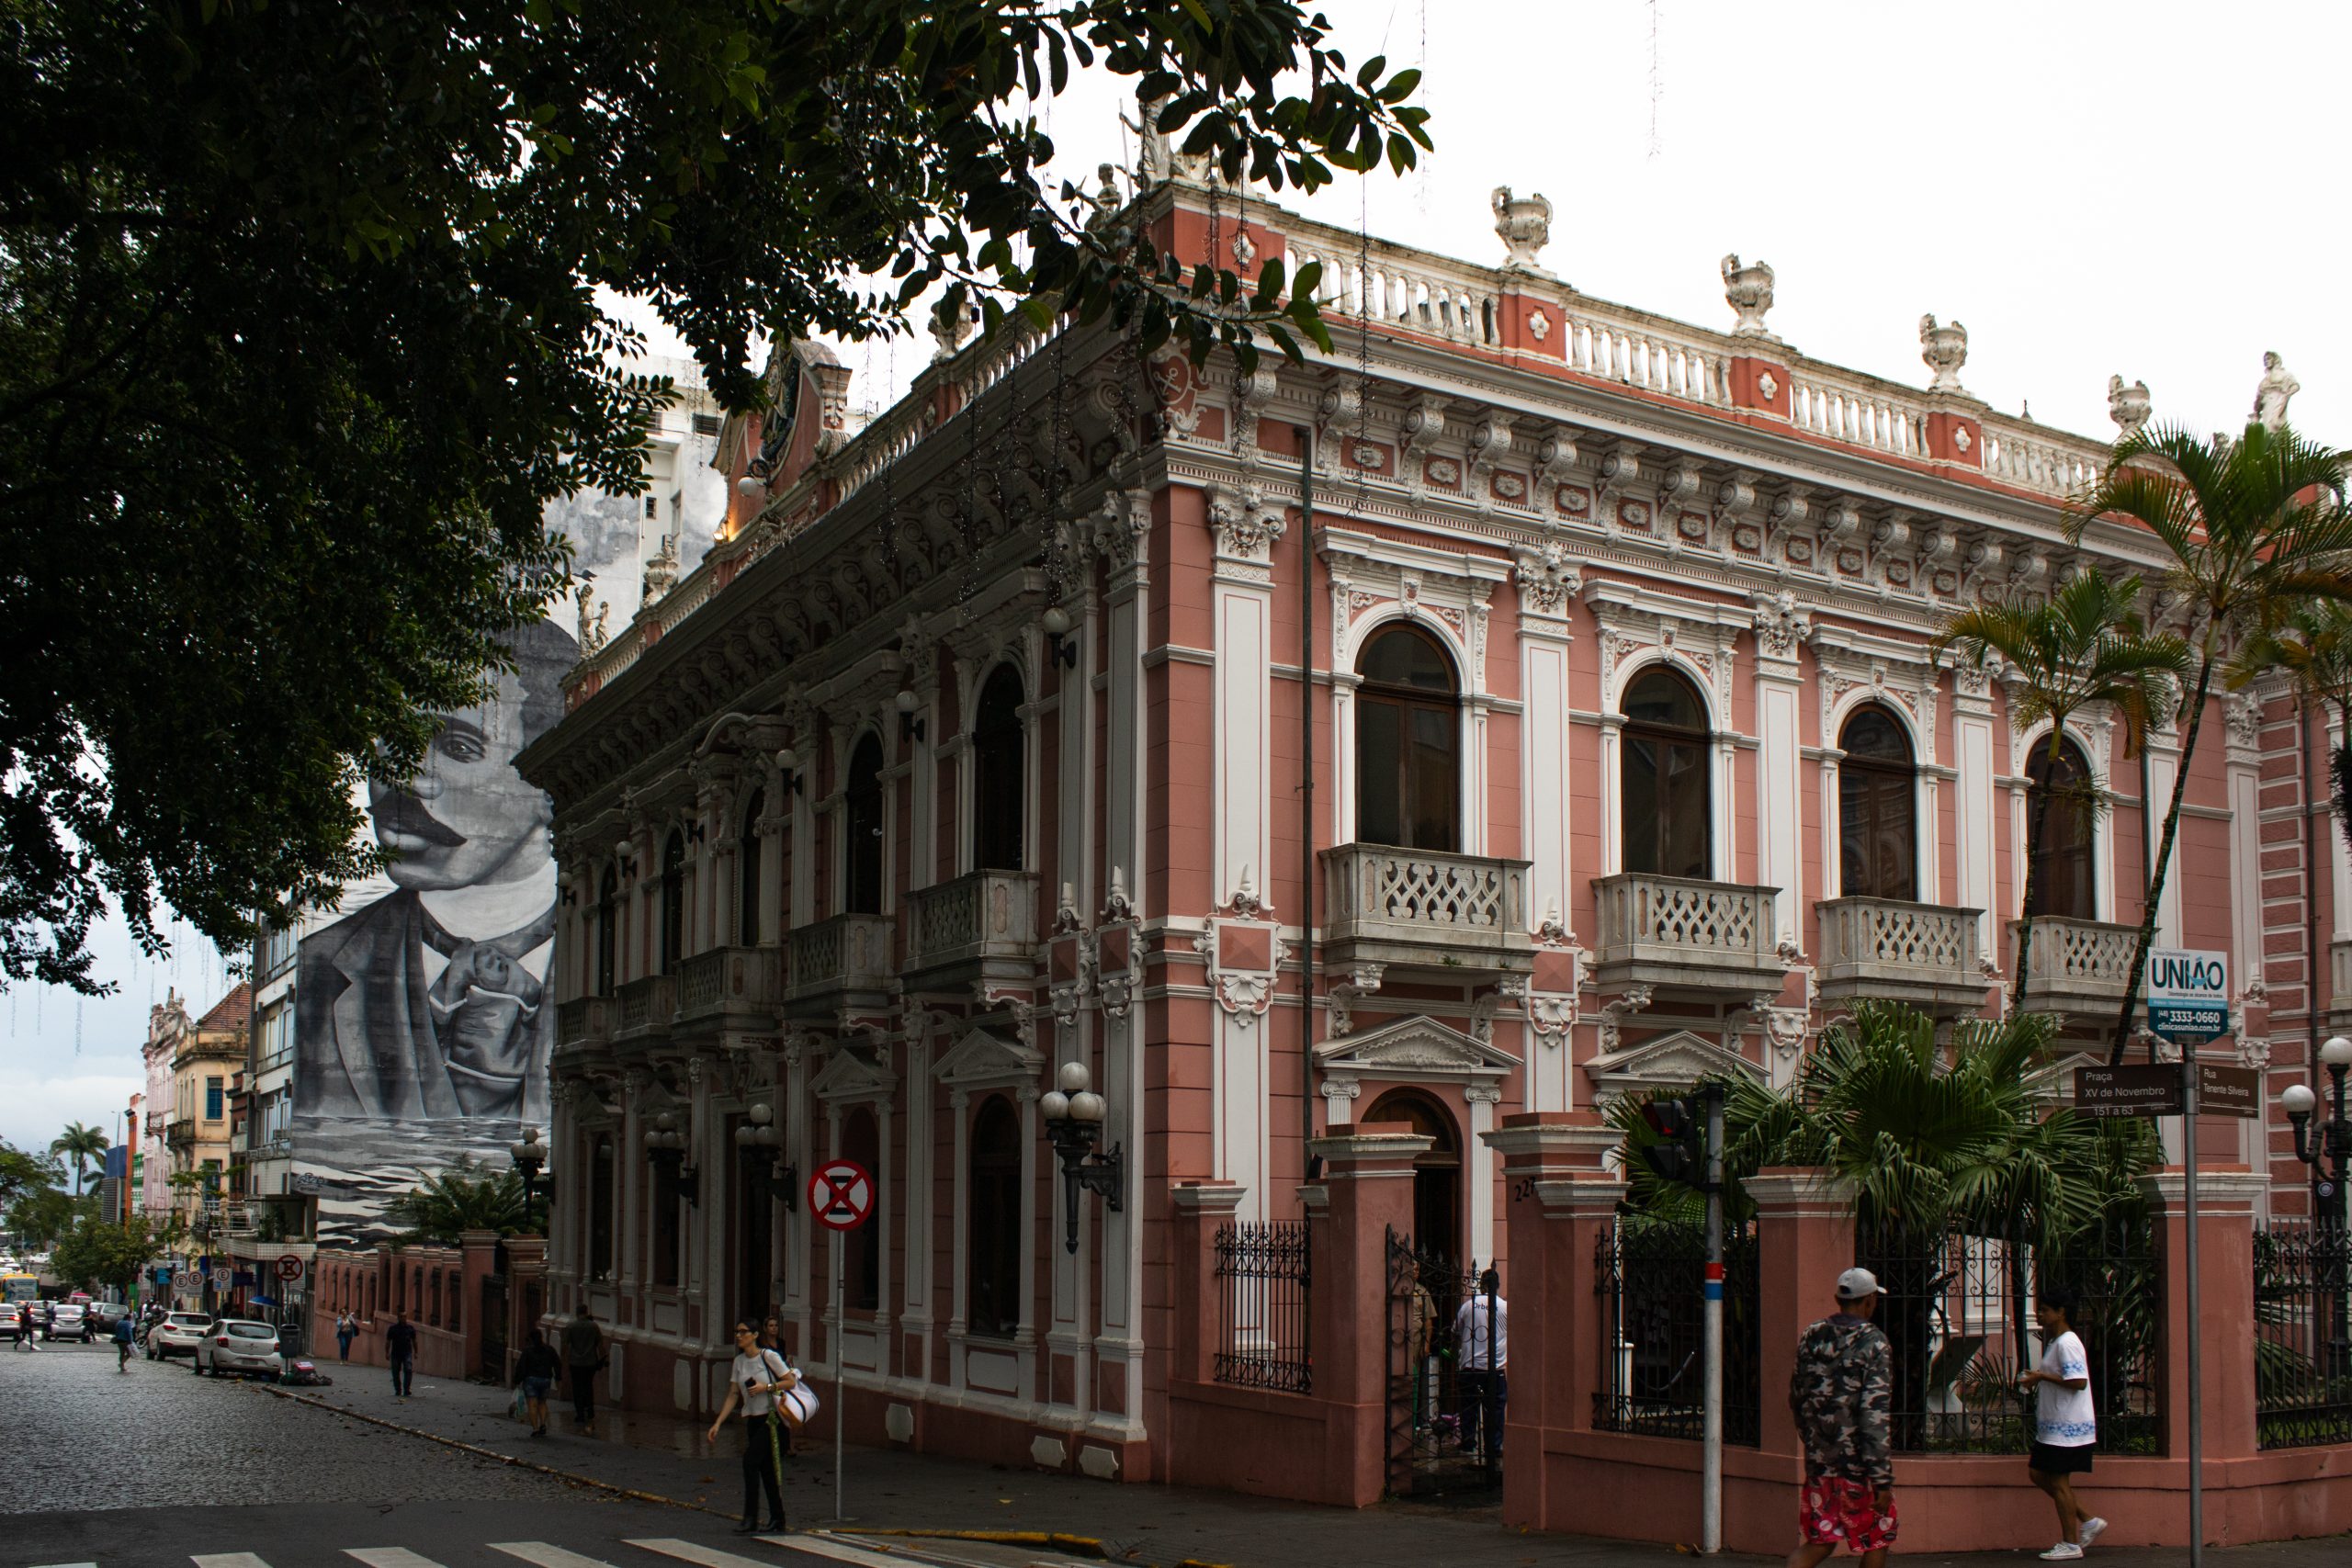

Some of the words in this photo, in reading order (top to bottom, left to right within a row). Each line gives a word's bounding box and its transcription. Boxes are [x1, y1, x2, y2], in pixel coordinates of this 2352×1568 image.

[2152, 956, 2223, 990] UNIÃO
[2169, 1010, 2221, 1023] 3333-0660
[2086, 1072, 2112, 1083] Praça
[2204, 1068, 2217, 1078] Rua
[2085, 1088, 2098, 1098] XV
[2100, 1088, 2113, 1098] de
[2115, 1087, 2165, 1097] Novembro
[2203, 1082, 2227, 1095] Tenente
[2227, 1085, 2249, 1097] Silveira
[2095, 1106, 2109, 1116] 151
[2113, 1108, 2120, 1116] a
[2121, 1106, 2133, 1116] 63
